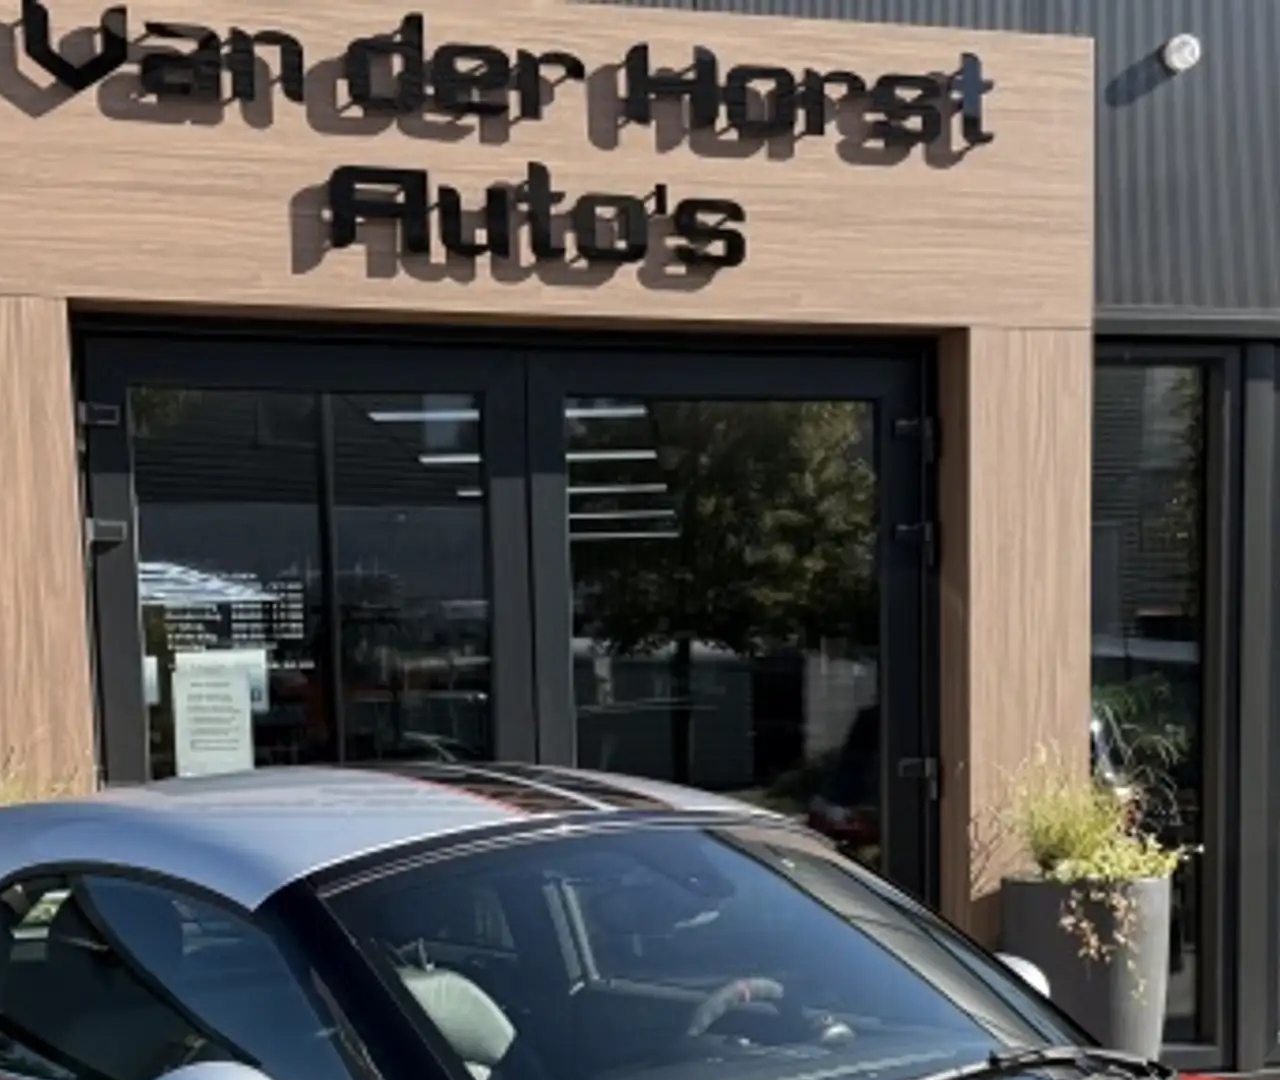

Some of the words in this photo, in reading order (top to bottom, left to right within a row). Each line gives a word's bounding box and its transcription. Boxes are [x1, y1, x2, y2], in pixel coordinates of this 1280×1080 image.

[22, 0, 305, 104] Van
[346, 12, 585, 120] der
[624, 42, 994, 147] Horst
[328, 162, 746, 267] Auto's
